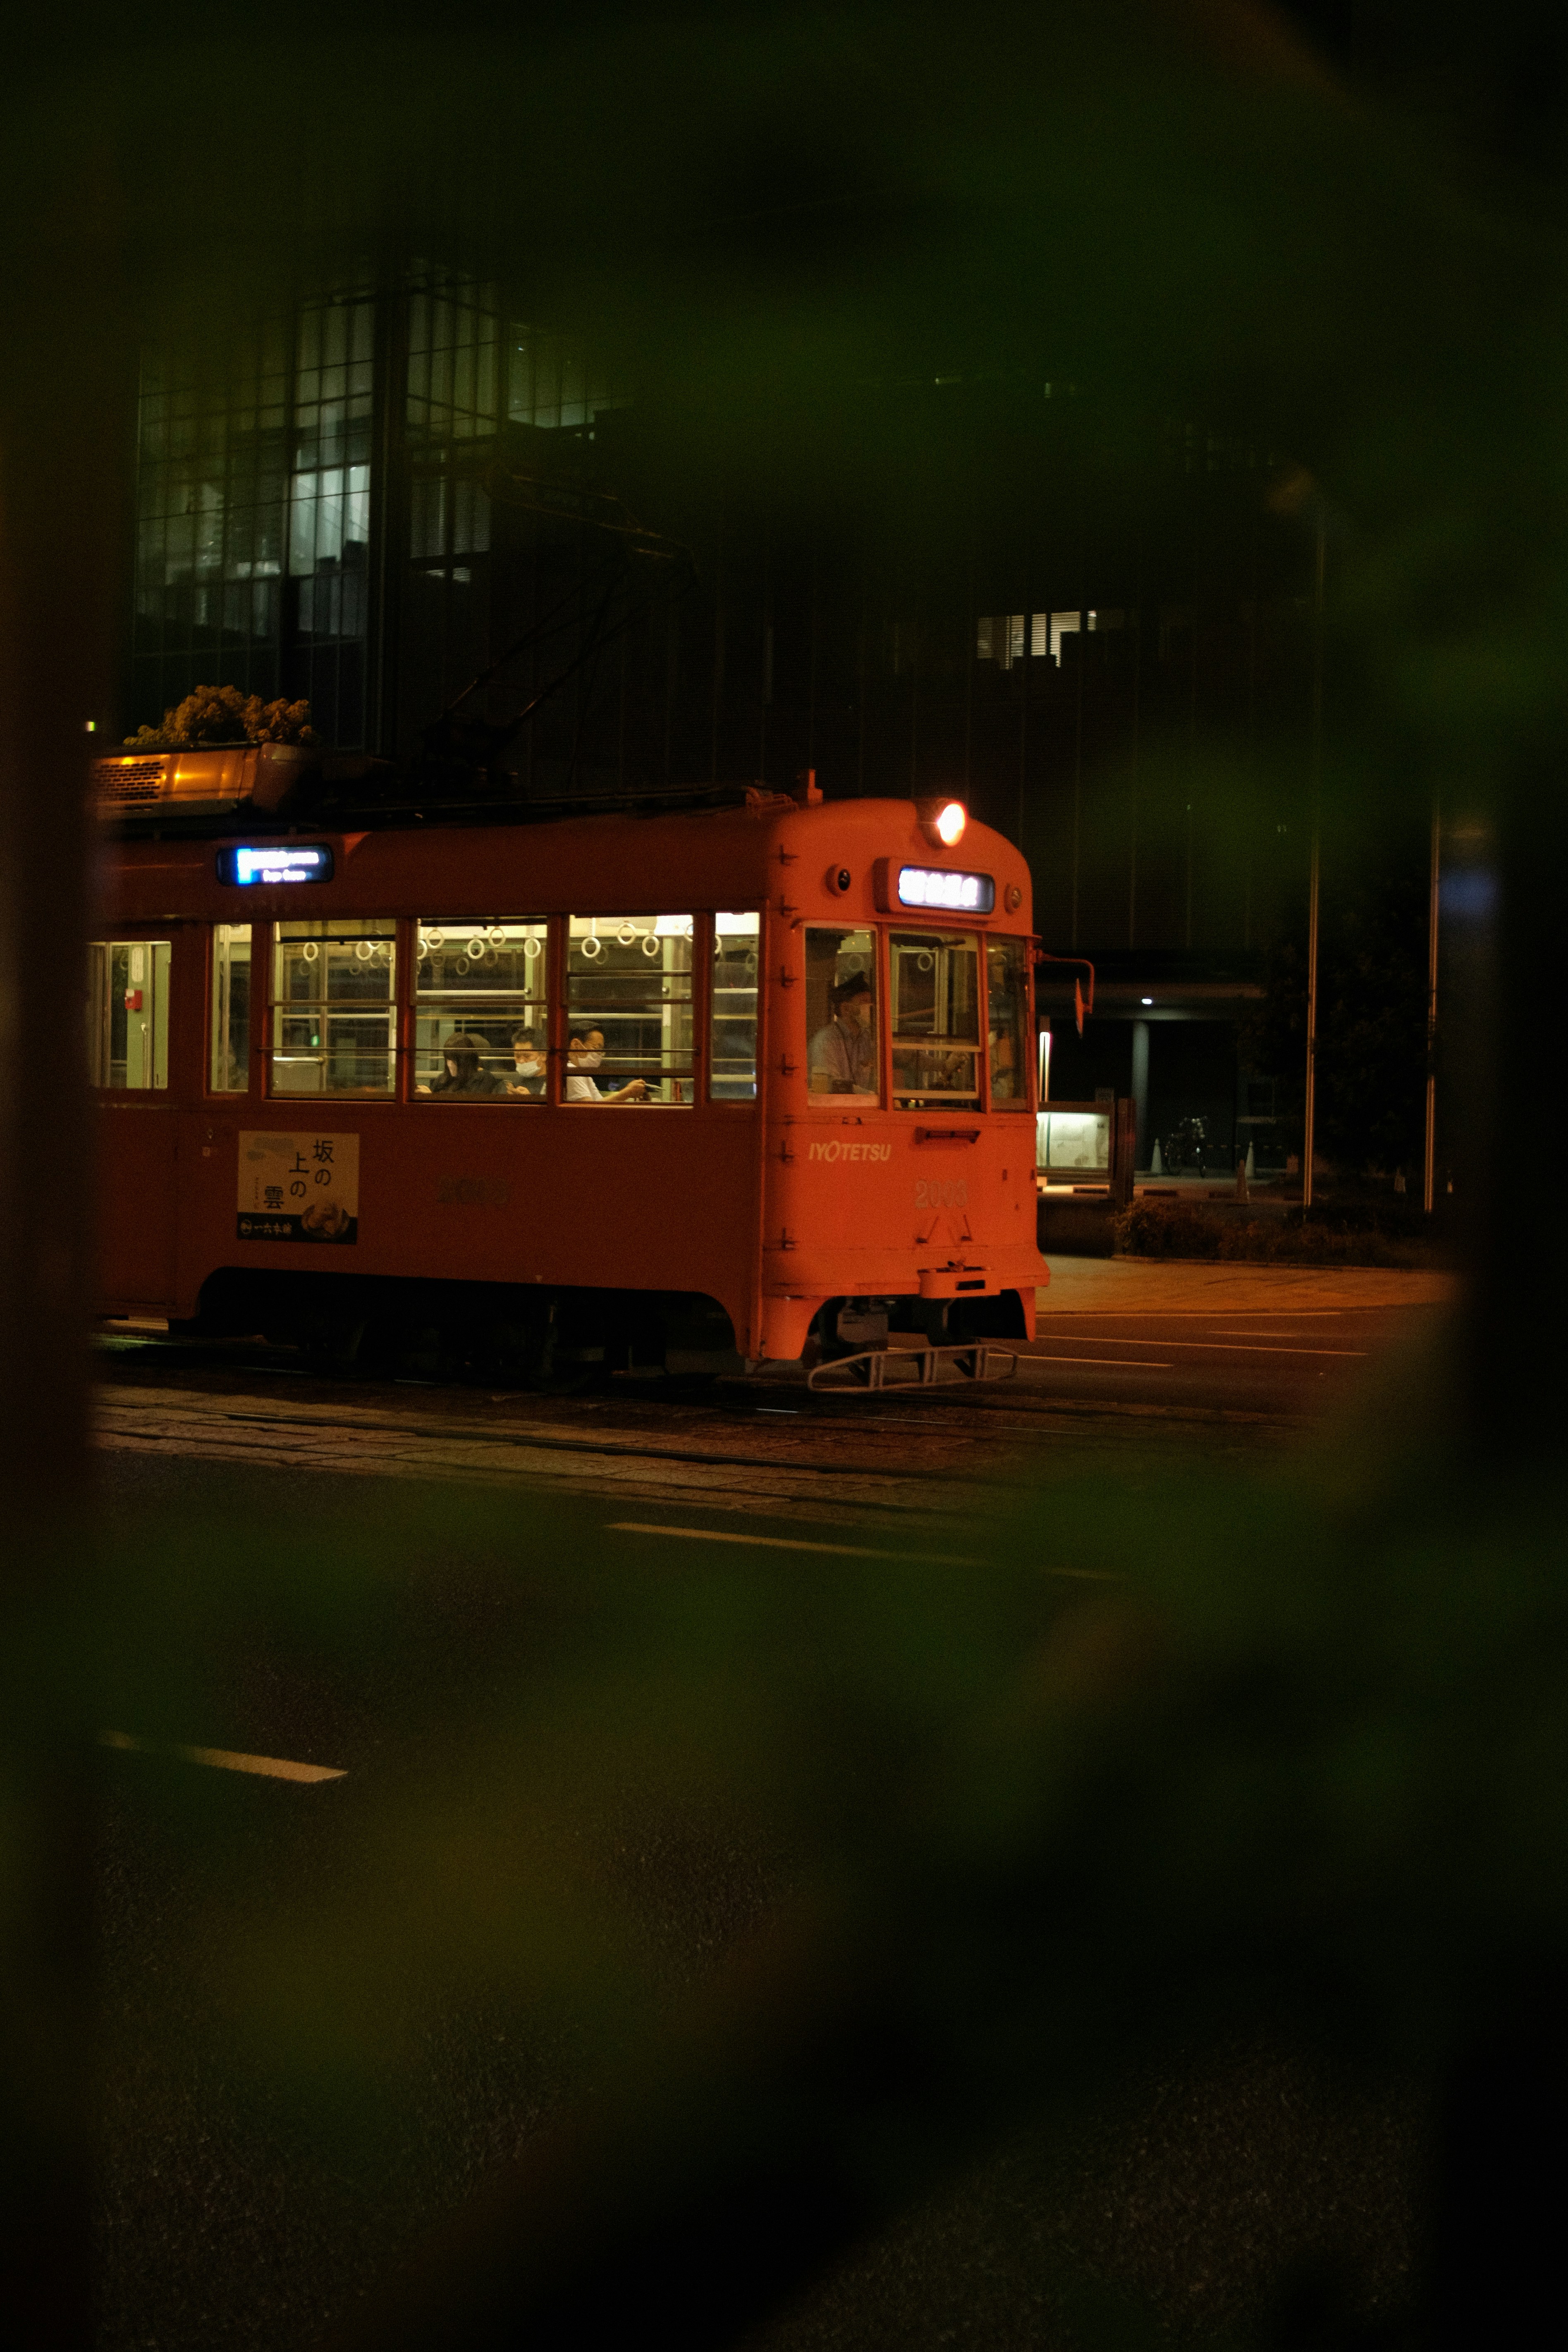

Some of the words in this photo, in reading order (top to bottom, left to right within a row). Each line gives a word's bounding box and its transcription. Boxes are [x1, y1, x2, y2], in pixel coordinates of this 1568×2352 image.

[313, 1139, 334, 1186] 坂の
[808, 1140, 892, 1162] IYOTETSU
[289, 1151, 309, 1198] 上の
[263, 1185, 284, 1209] 雲
